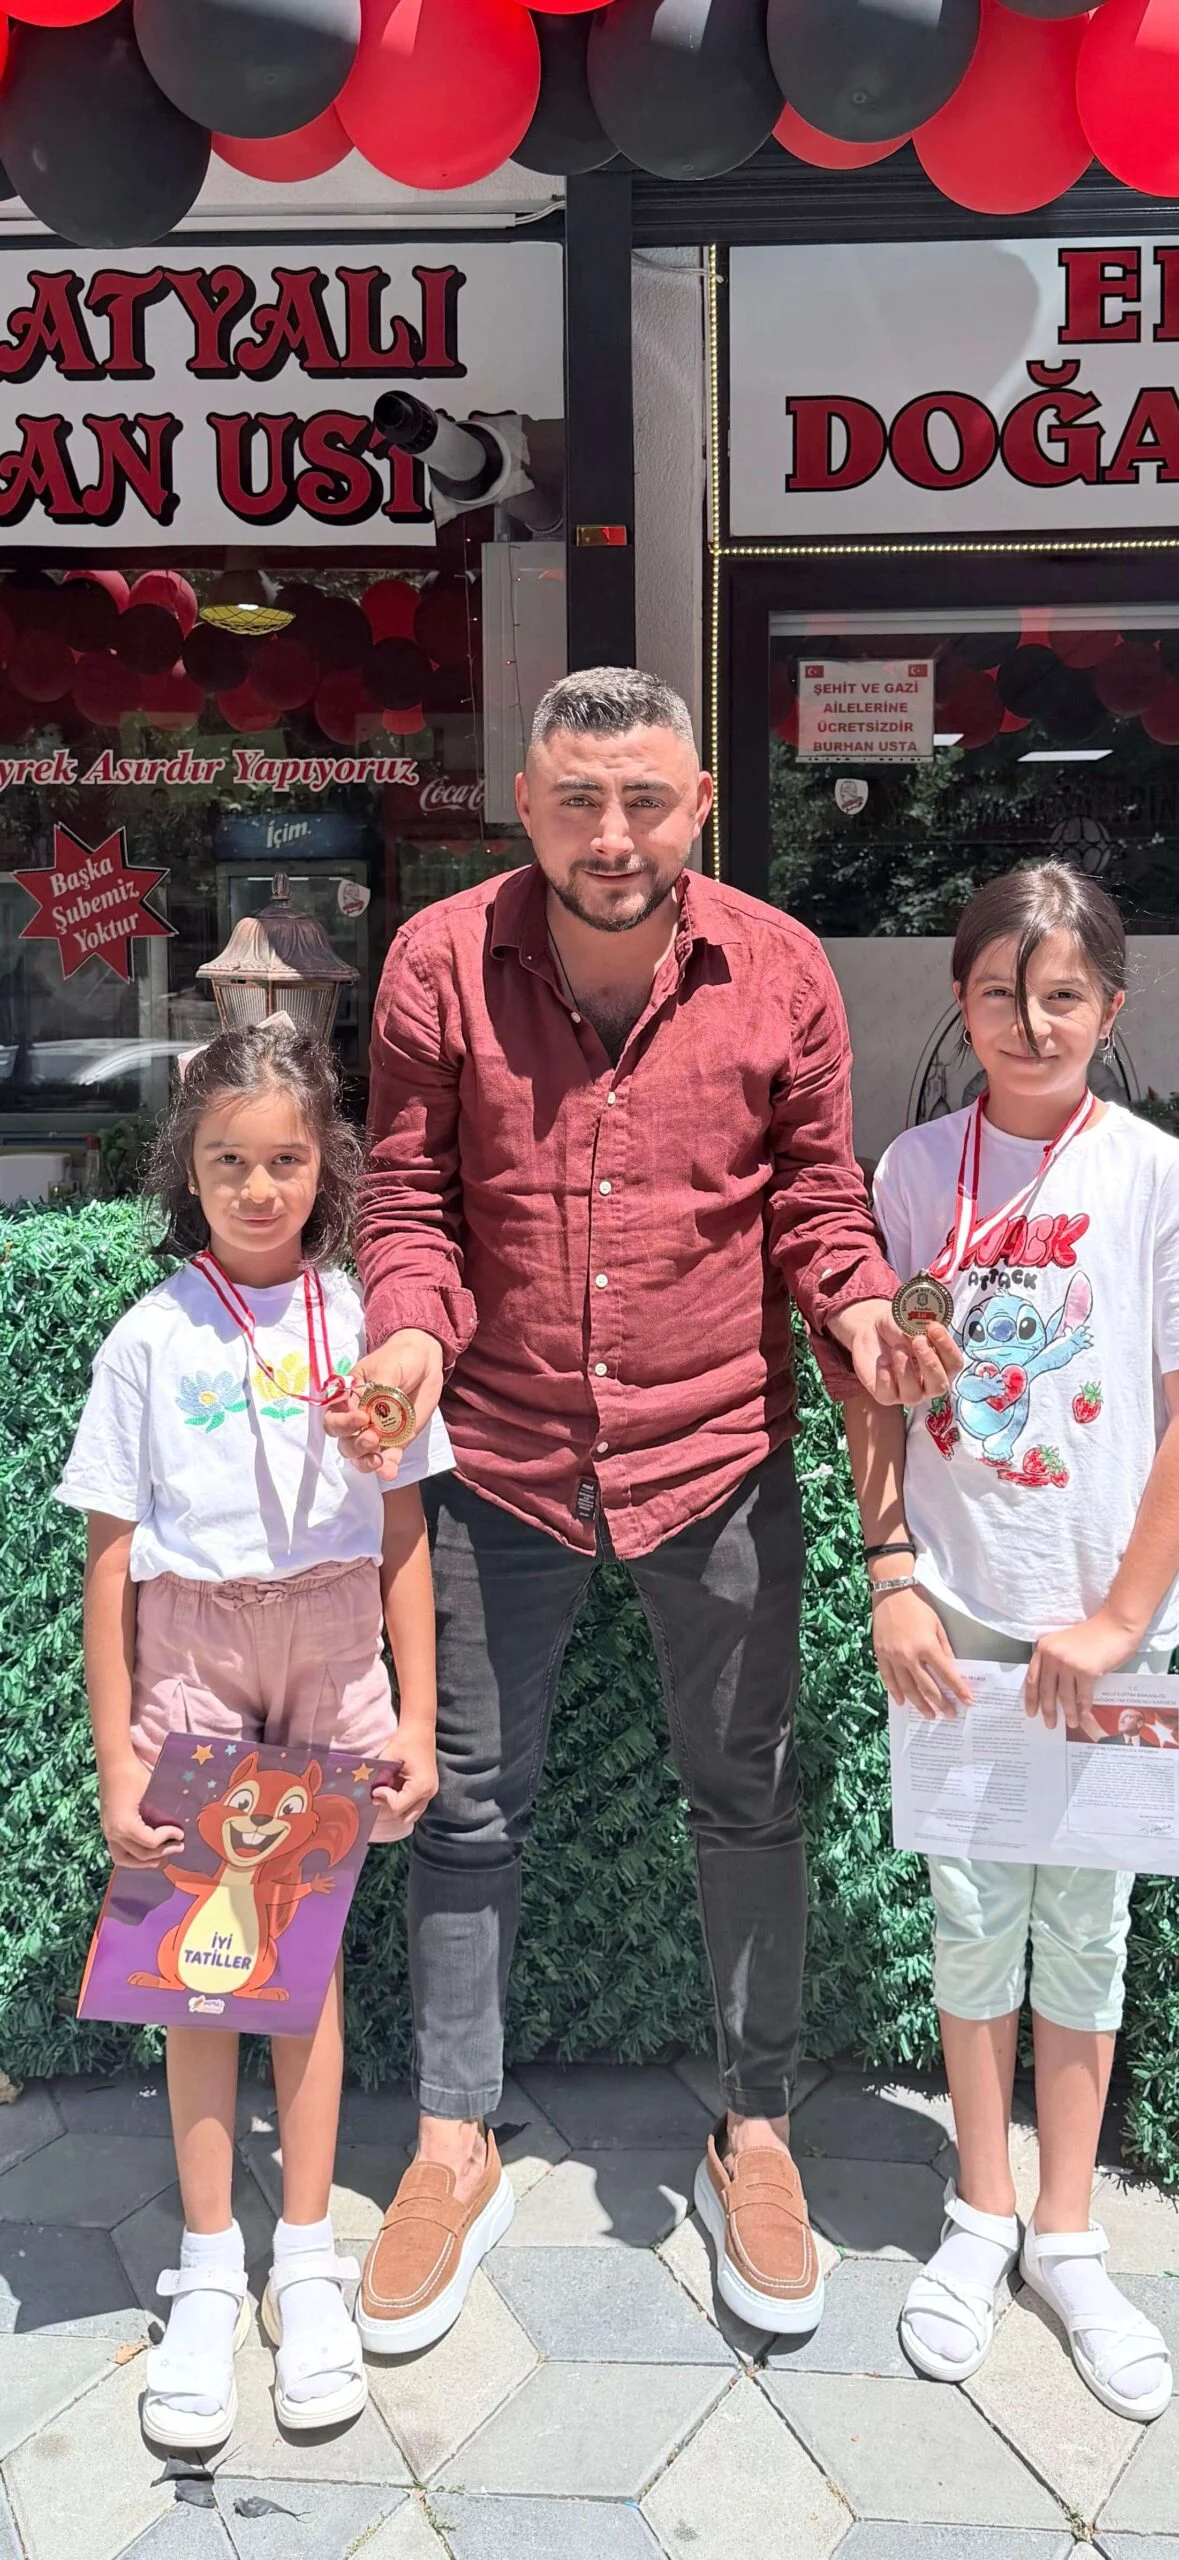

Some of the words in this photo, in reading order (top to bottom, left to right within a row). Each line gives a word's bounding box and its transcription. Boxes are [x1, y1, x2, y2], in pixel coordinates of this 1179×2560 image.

[0, 264, 467, 381] ATYALI
[786, 359, 1179, 492] DOĞA
[207, 408, 516, 526] UST
[813, 682, 857, 695] ŞEHİT
[861, 683, 880, 694] VE
[884, 681, 919, 694] GAZİ
[823, 701, 908, 713] AİLELERİNE
[817, 720, 914, 733] ÜCRETSİZDİR
[813, 740, 874, 752] BURHAN
[878, 740, 917, 752] USTA
[81, 749, 225, 785] Asırdır
[232, 749, 419, 792] Yapıyoruz
[49, 857, 114, 898] Başka
[52, 878, 140, 935] Şubemiz
[73, 912, 139, 953] Yoktur
[968, 1268, 1038, 1291] ATTACK
[211, 1930, 232, 1950] İYİ
[184, 1949, 252, 1971] TATİLLER
